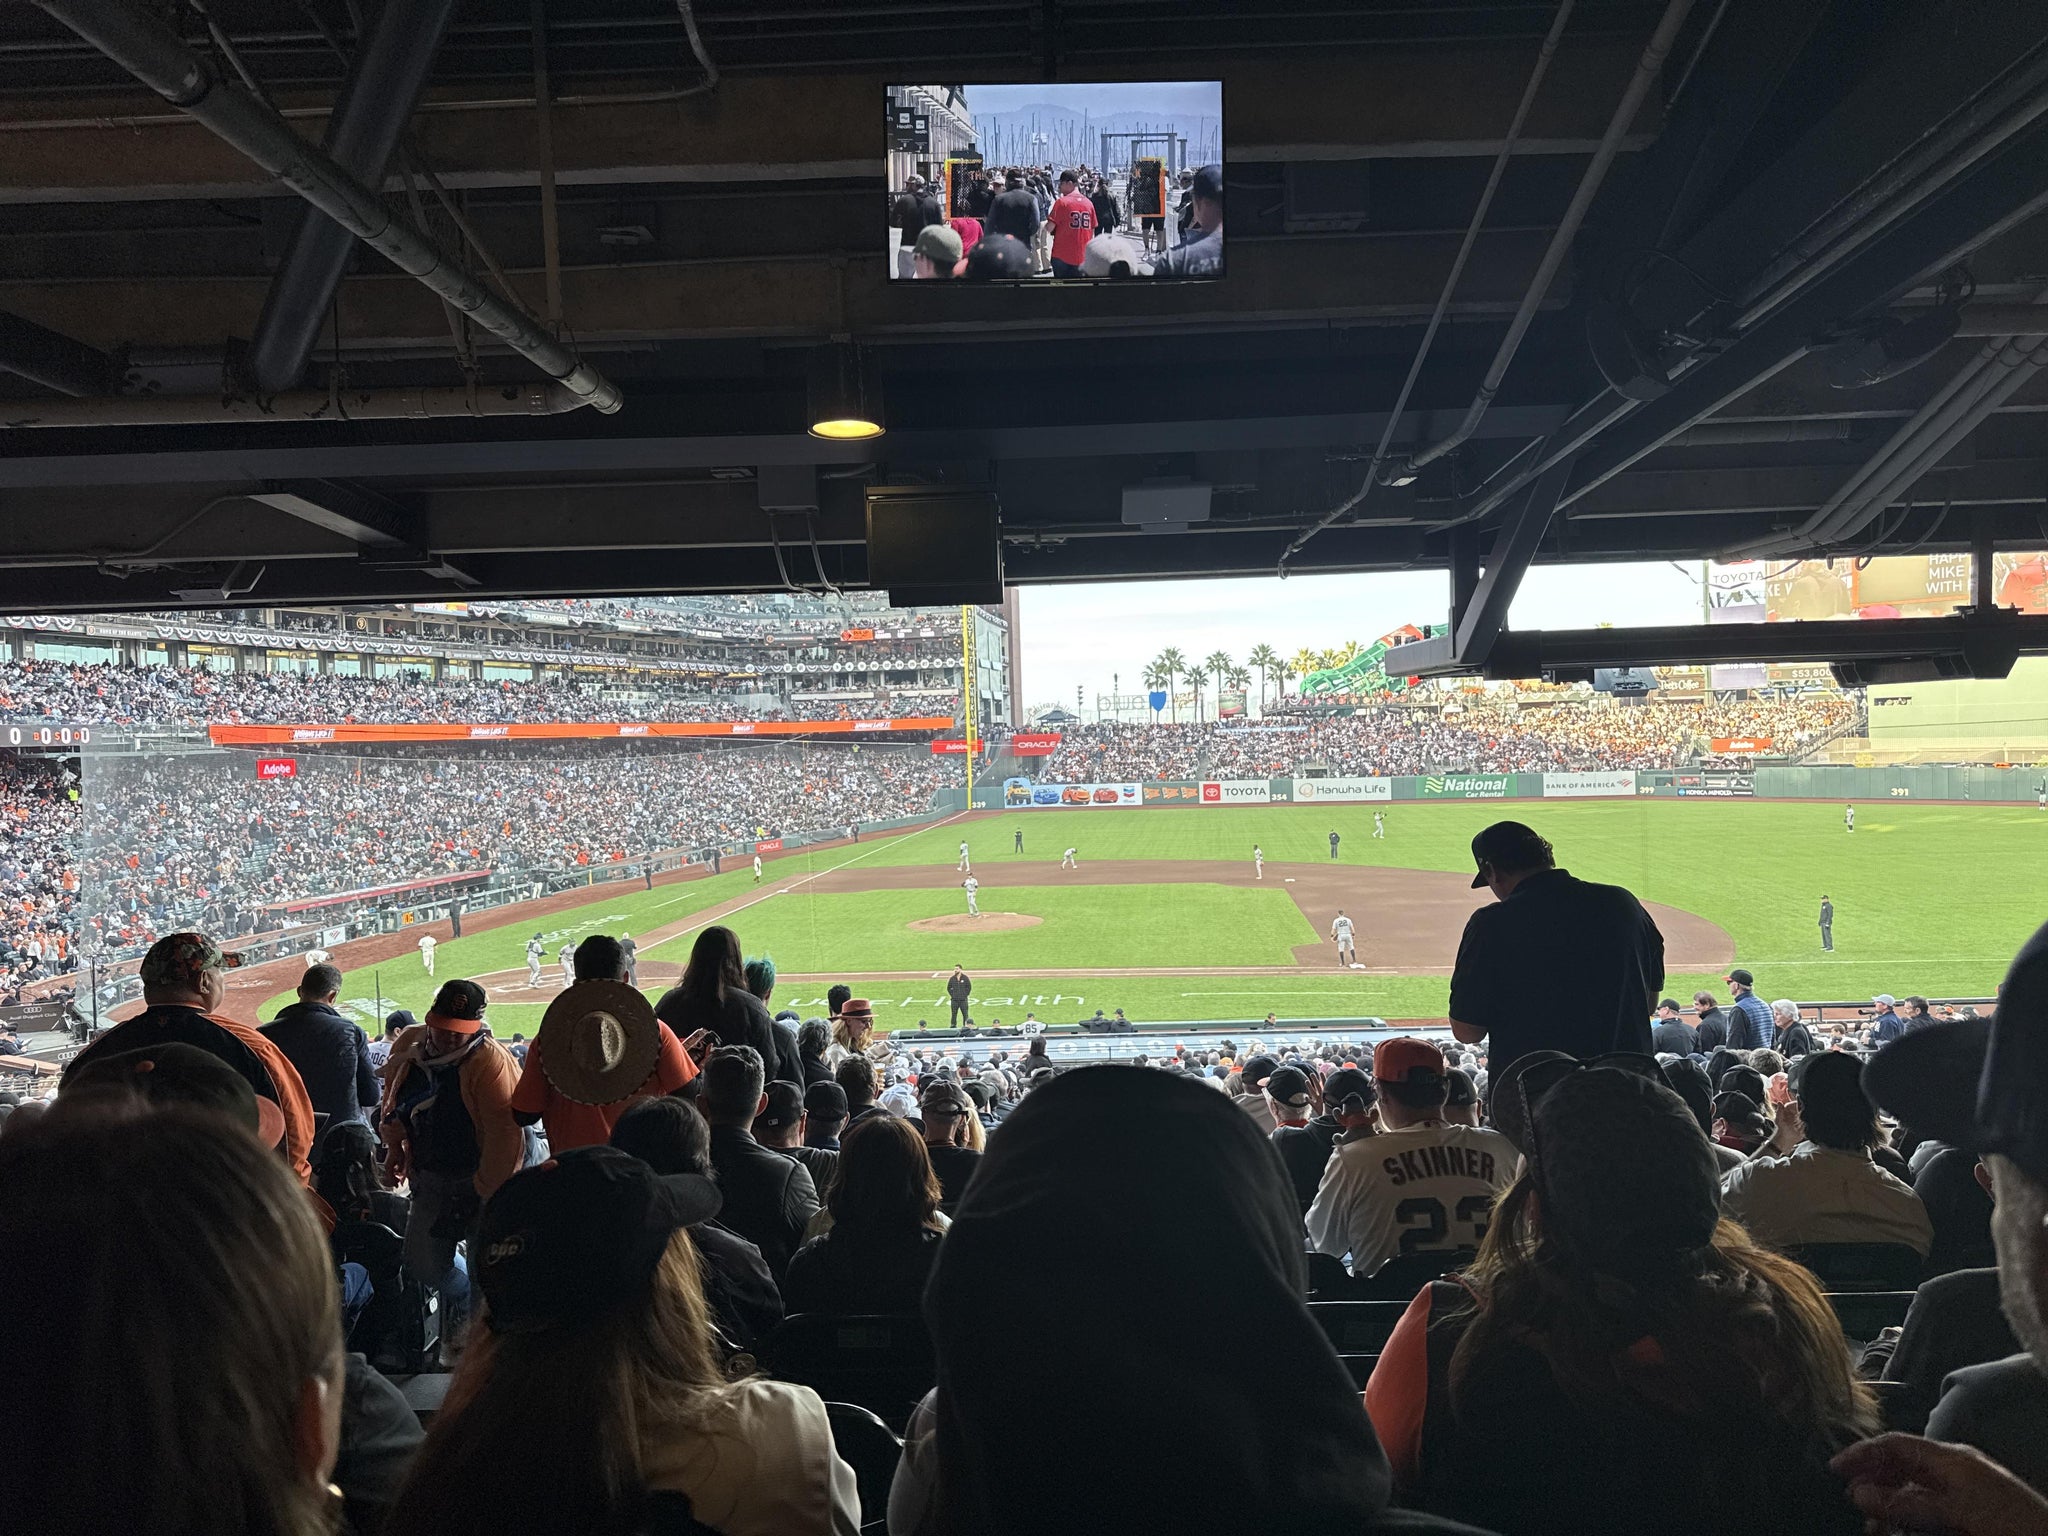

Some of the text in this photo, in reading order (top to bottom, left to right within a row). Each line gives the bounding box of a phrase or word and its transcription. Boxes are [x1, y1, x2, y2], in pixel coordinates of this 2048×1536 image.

[1070, 211, 1091, 229] 36
[1713, 571, 1764, 584] TOYOTA
[1929, 565, 1965, 580] MIKE
[1925, 580, 1963, 594] WITH
[10, 727, 21, 745] 0
[33, 732, 40, 741] B
[41, 727, 52, 745] 0
[54, 732, 61, 741] S
[61, 727, 71, 745] 0
[1018, 741, 1057, 749] ORACLE
[263, 764, 291, 775] Adobe
[1444, 777, 1507, 791] National
[1580, 781, 1615, 789] AMERICA
[1225, 787, 1266, 797] TOYOTA
[1317, 785, 1386, 795] Hanwha Life
[1479, 790, 1504, 798] Rental
[1640, 786, 1655, 794] 399
[1891, 788, 1909, 796] 391
[1271, 793, 1287, 801] 354
[972, 801, 986, 809] 339
[1025, 1023, 1037, 1033] 85
[1382, 1146, 1495, 1186] SKINNER
